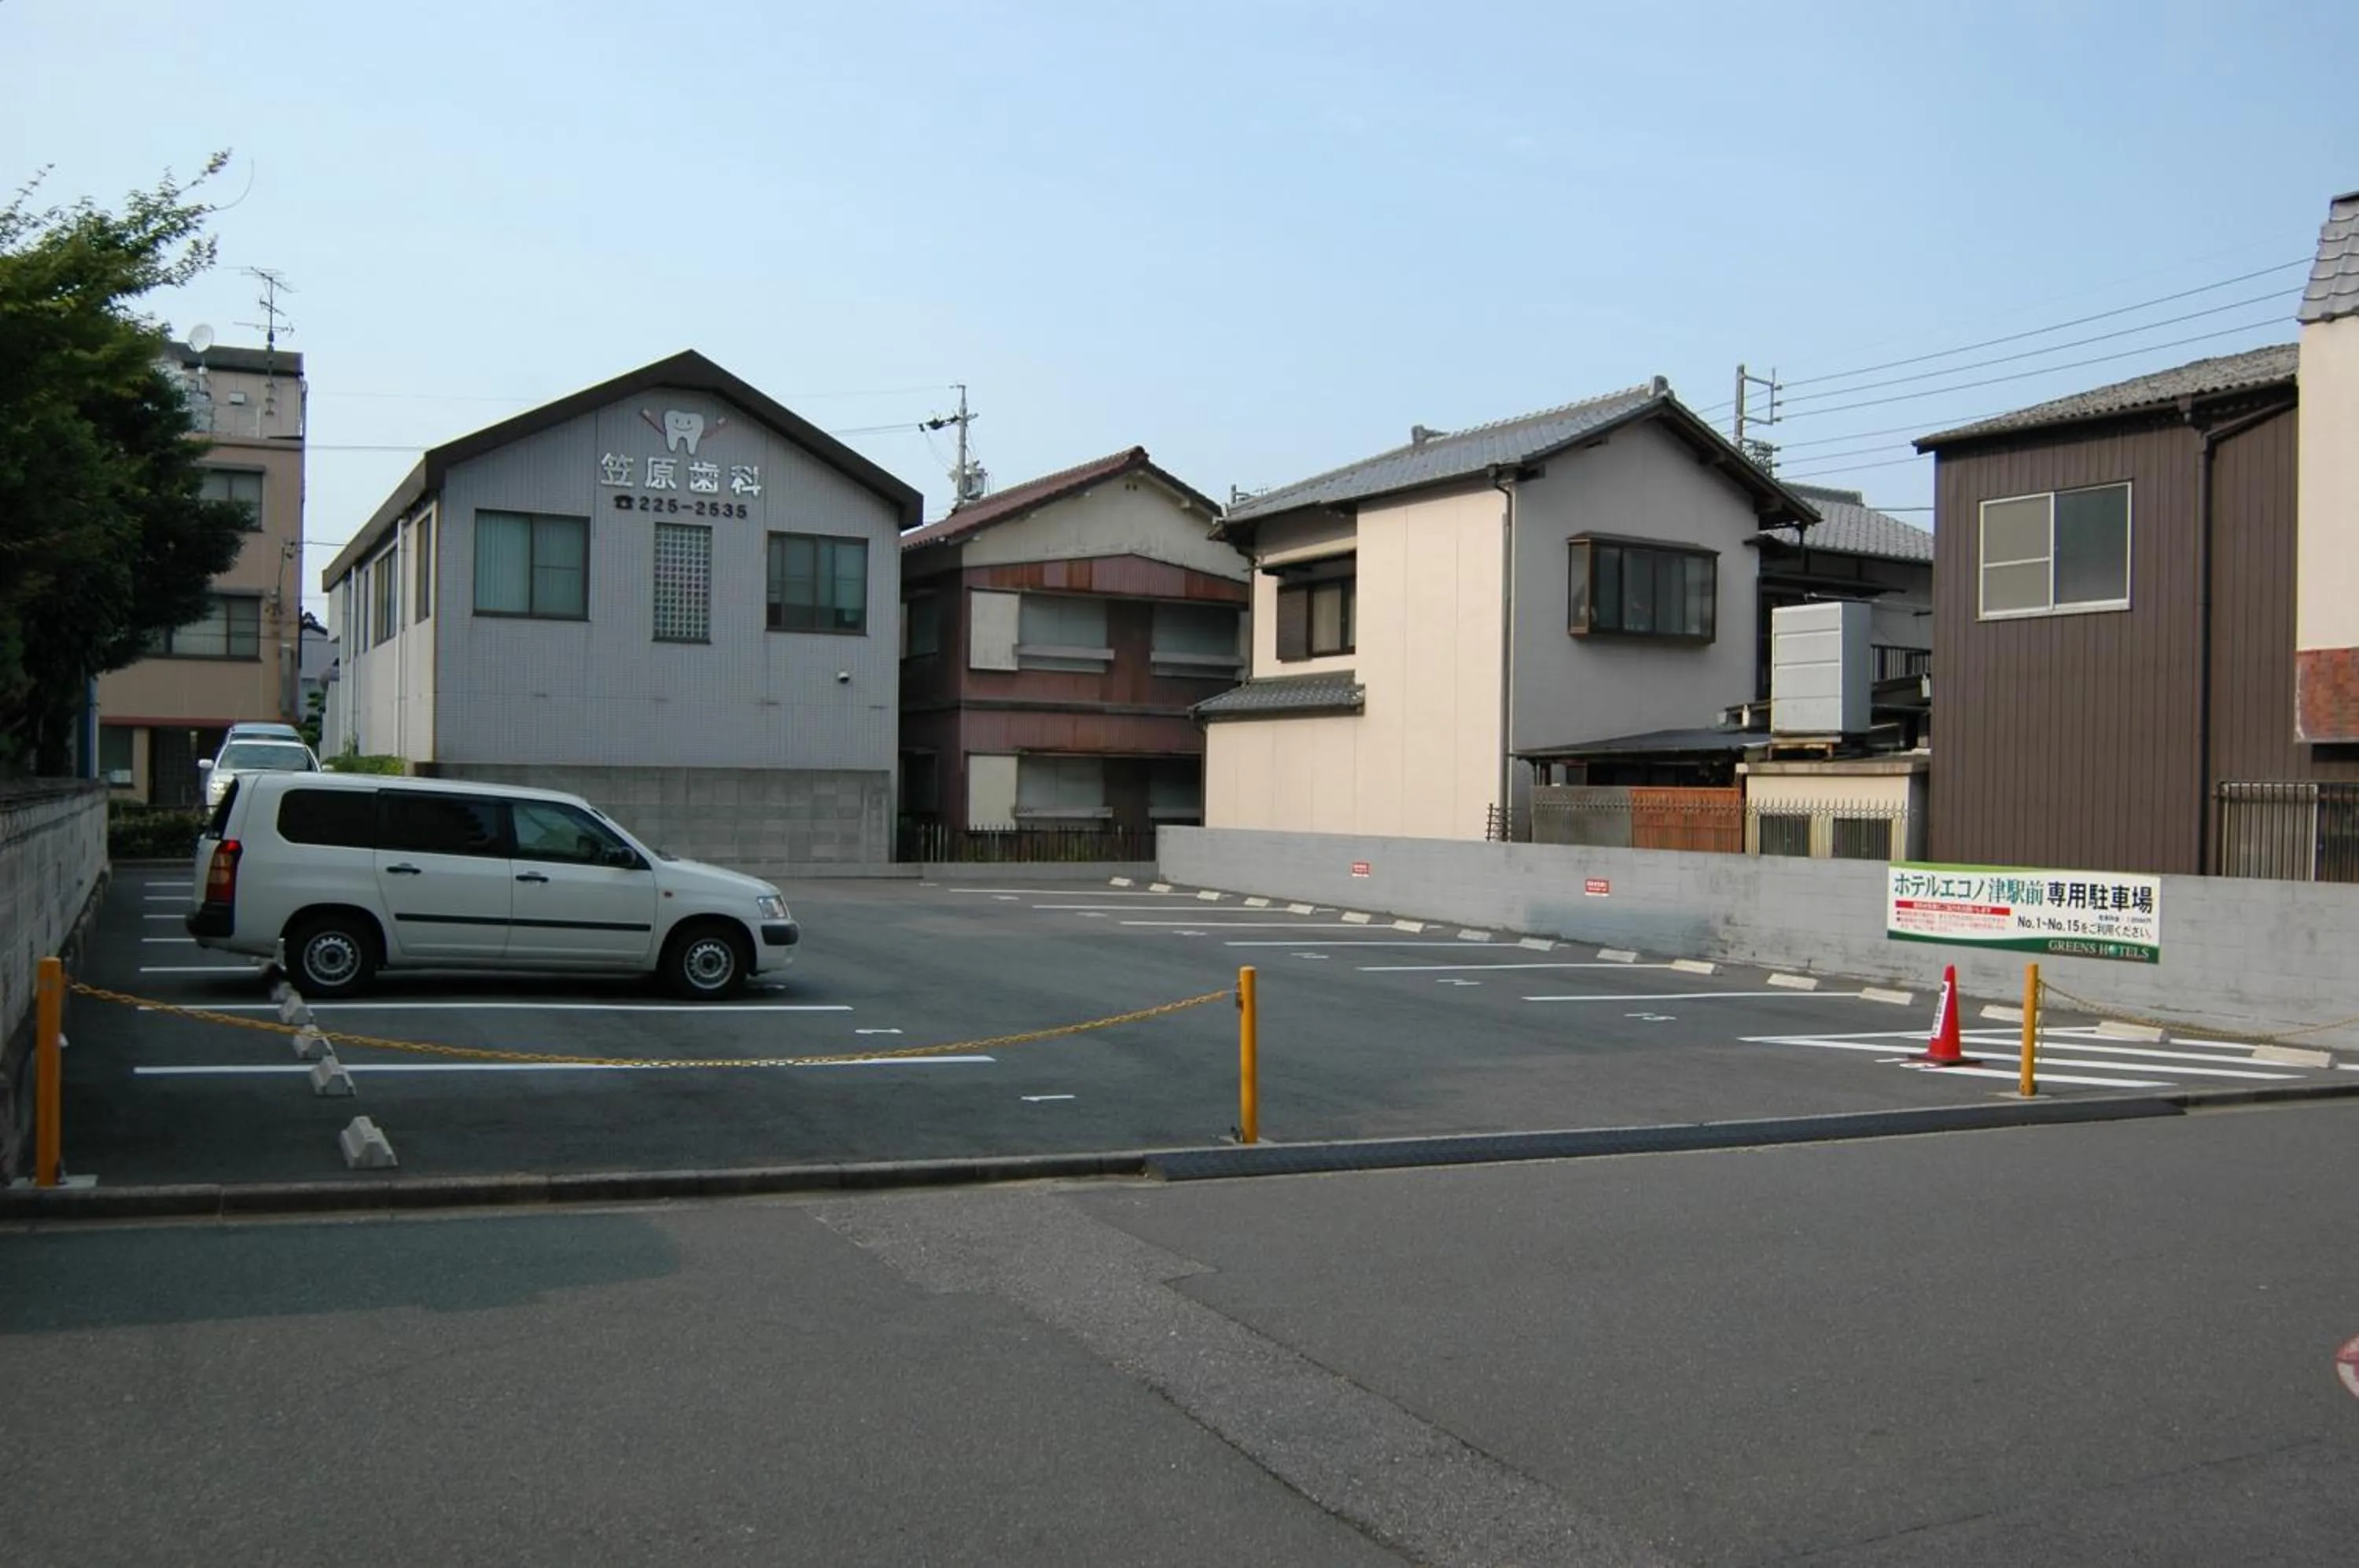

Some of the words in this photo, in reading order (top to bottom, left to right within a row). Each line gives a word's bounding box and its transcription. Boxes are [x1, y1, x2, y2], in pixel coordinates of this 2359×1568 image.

[601, 452, 762, 497] 笠原歯科
[639, 496, 748, 519] 225-2535
[2048, 940, 2097, 955] GREENS
[2099, 943, 2150, 959] HOTELS
